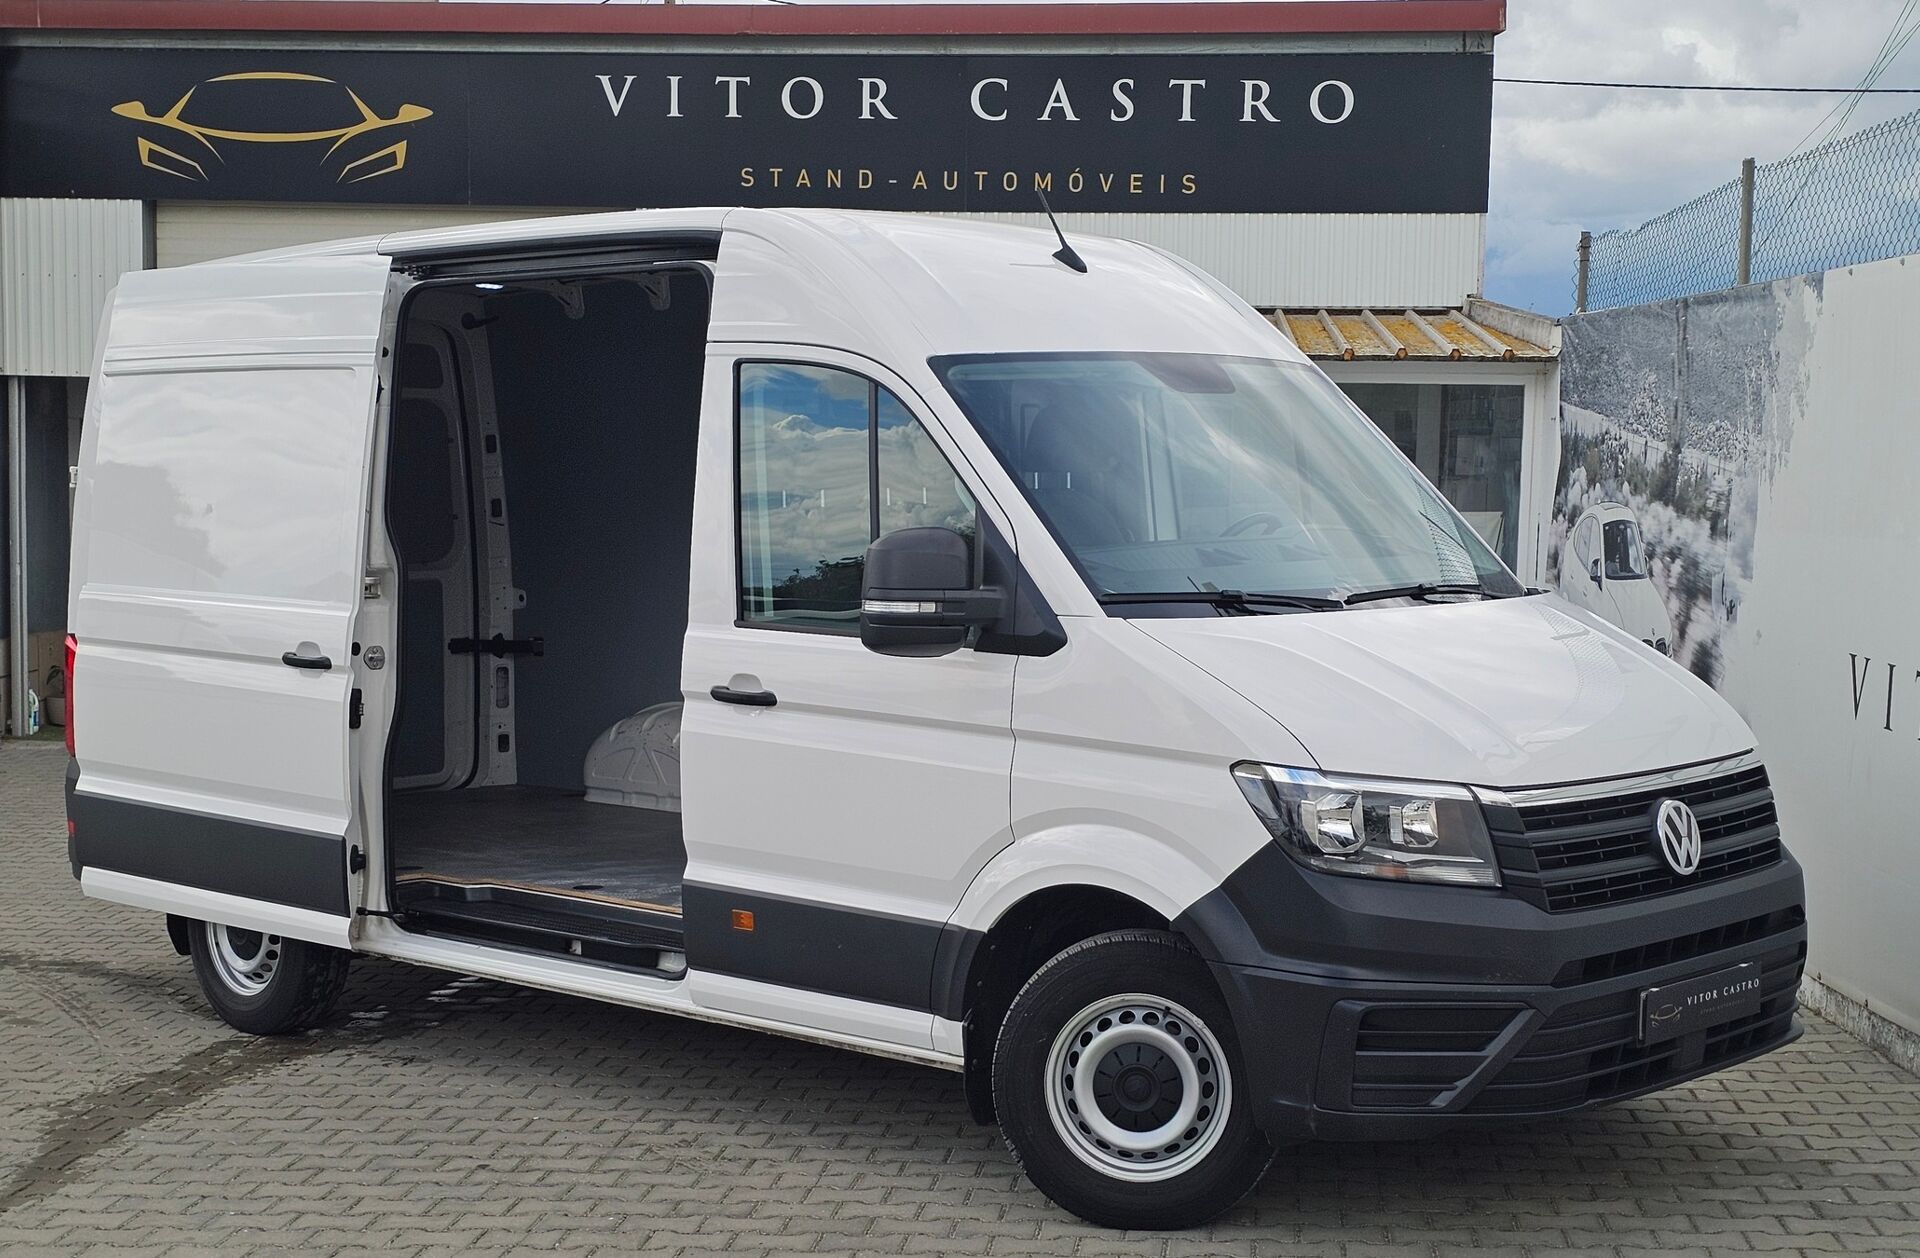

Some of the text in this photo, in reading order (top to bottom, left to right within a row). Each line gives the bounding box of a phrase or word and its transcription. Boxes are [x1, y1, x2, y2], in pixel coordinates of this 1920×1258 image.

[595, 74, 1355, 124] VITOR CASTRO
[1848, 652, 1920, 742] VI
[1686, 978, 1760, 1006] VITOR CASTRO
